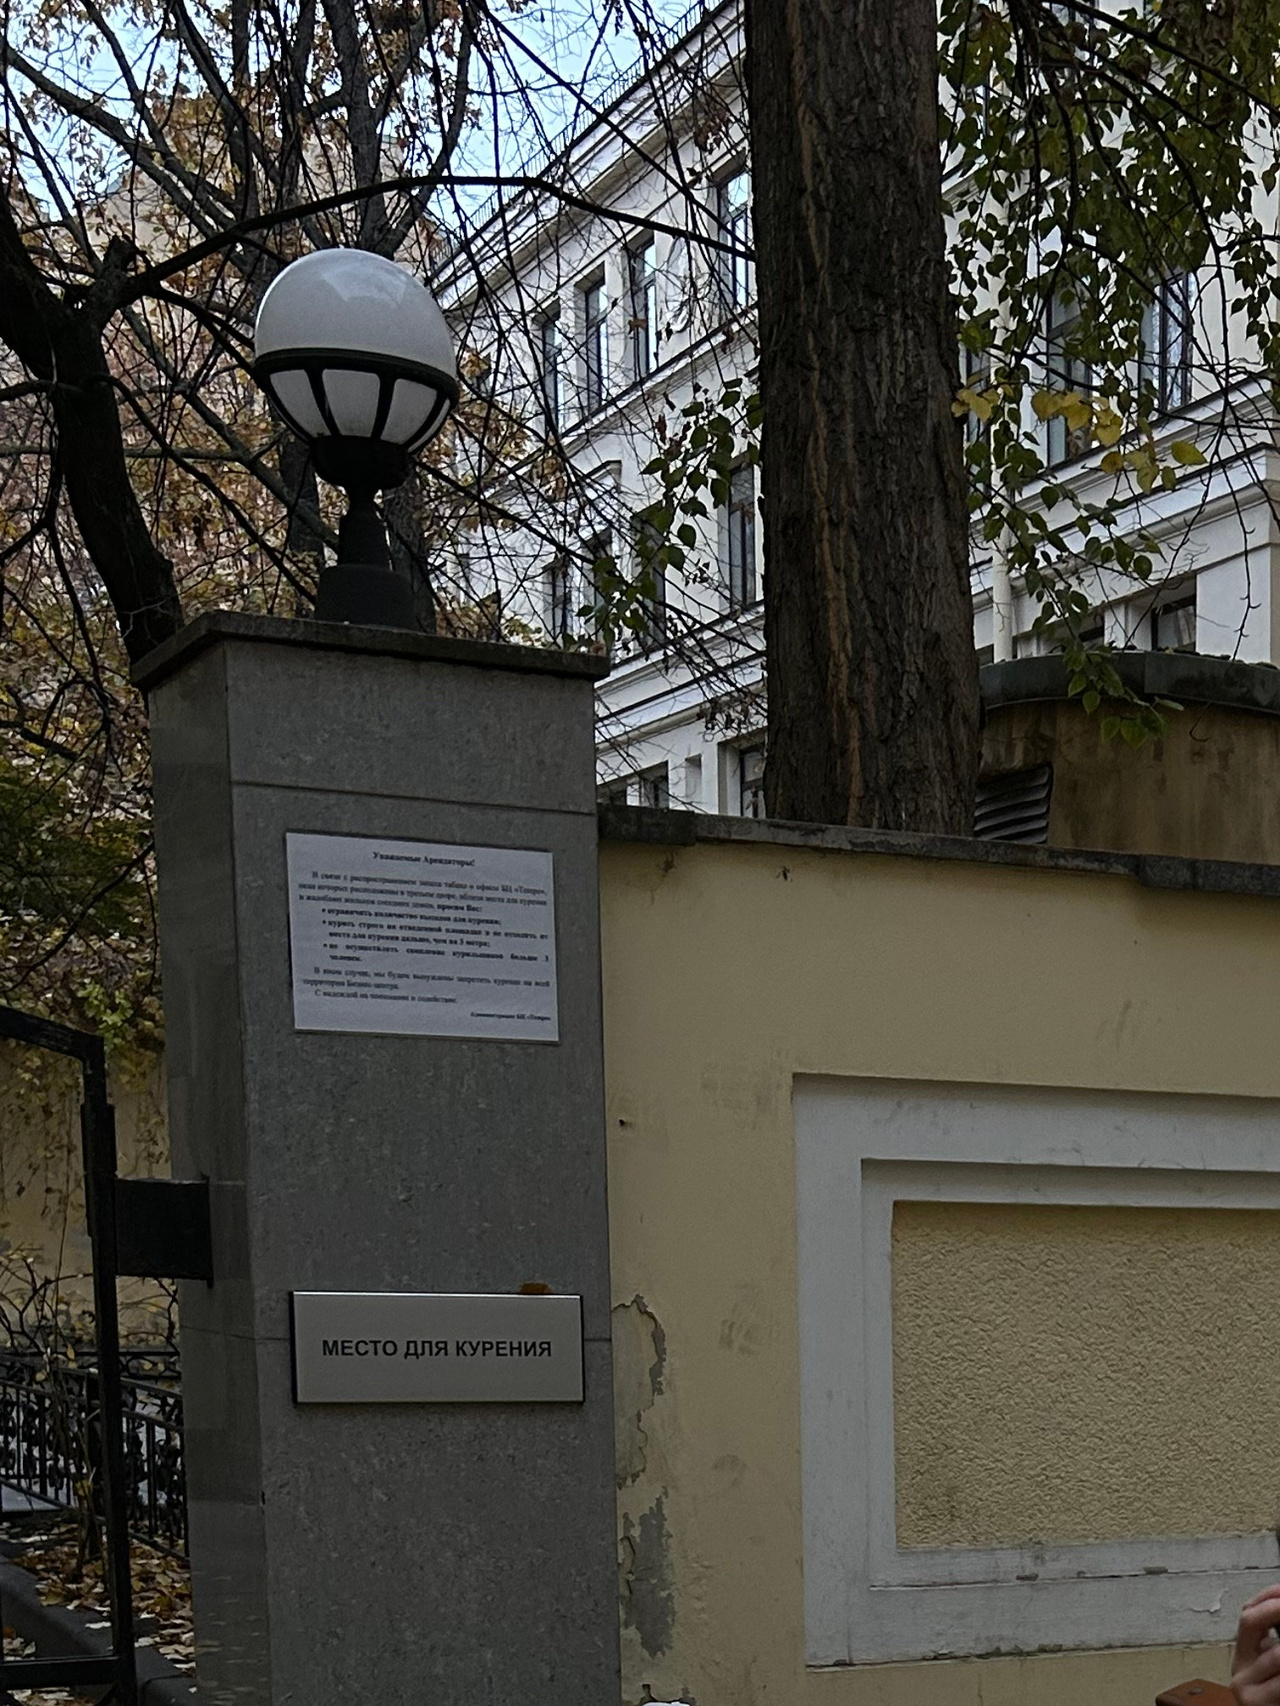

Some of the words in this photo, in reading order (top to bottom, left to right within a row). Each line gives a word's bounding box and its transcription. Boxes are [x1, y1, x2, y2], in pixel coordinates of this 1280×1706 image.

[322, 1340, 398, 1356] МЕСТО
[404, 1340, 448, 1359] ДЛЯ
[456, 1341, 551, 1357] КУРЕНИЯ
